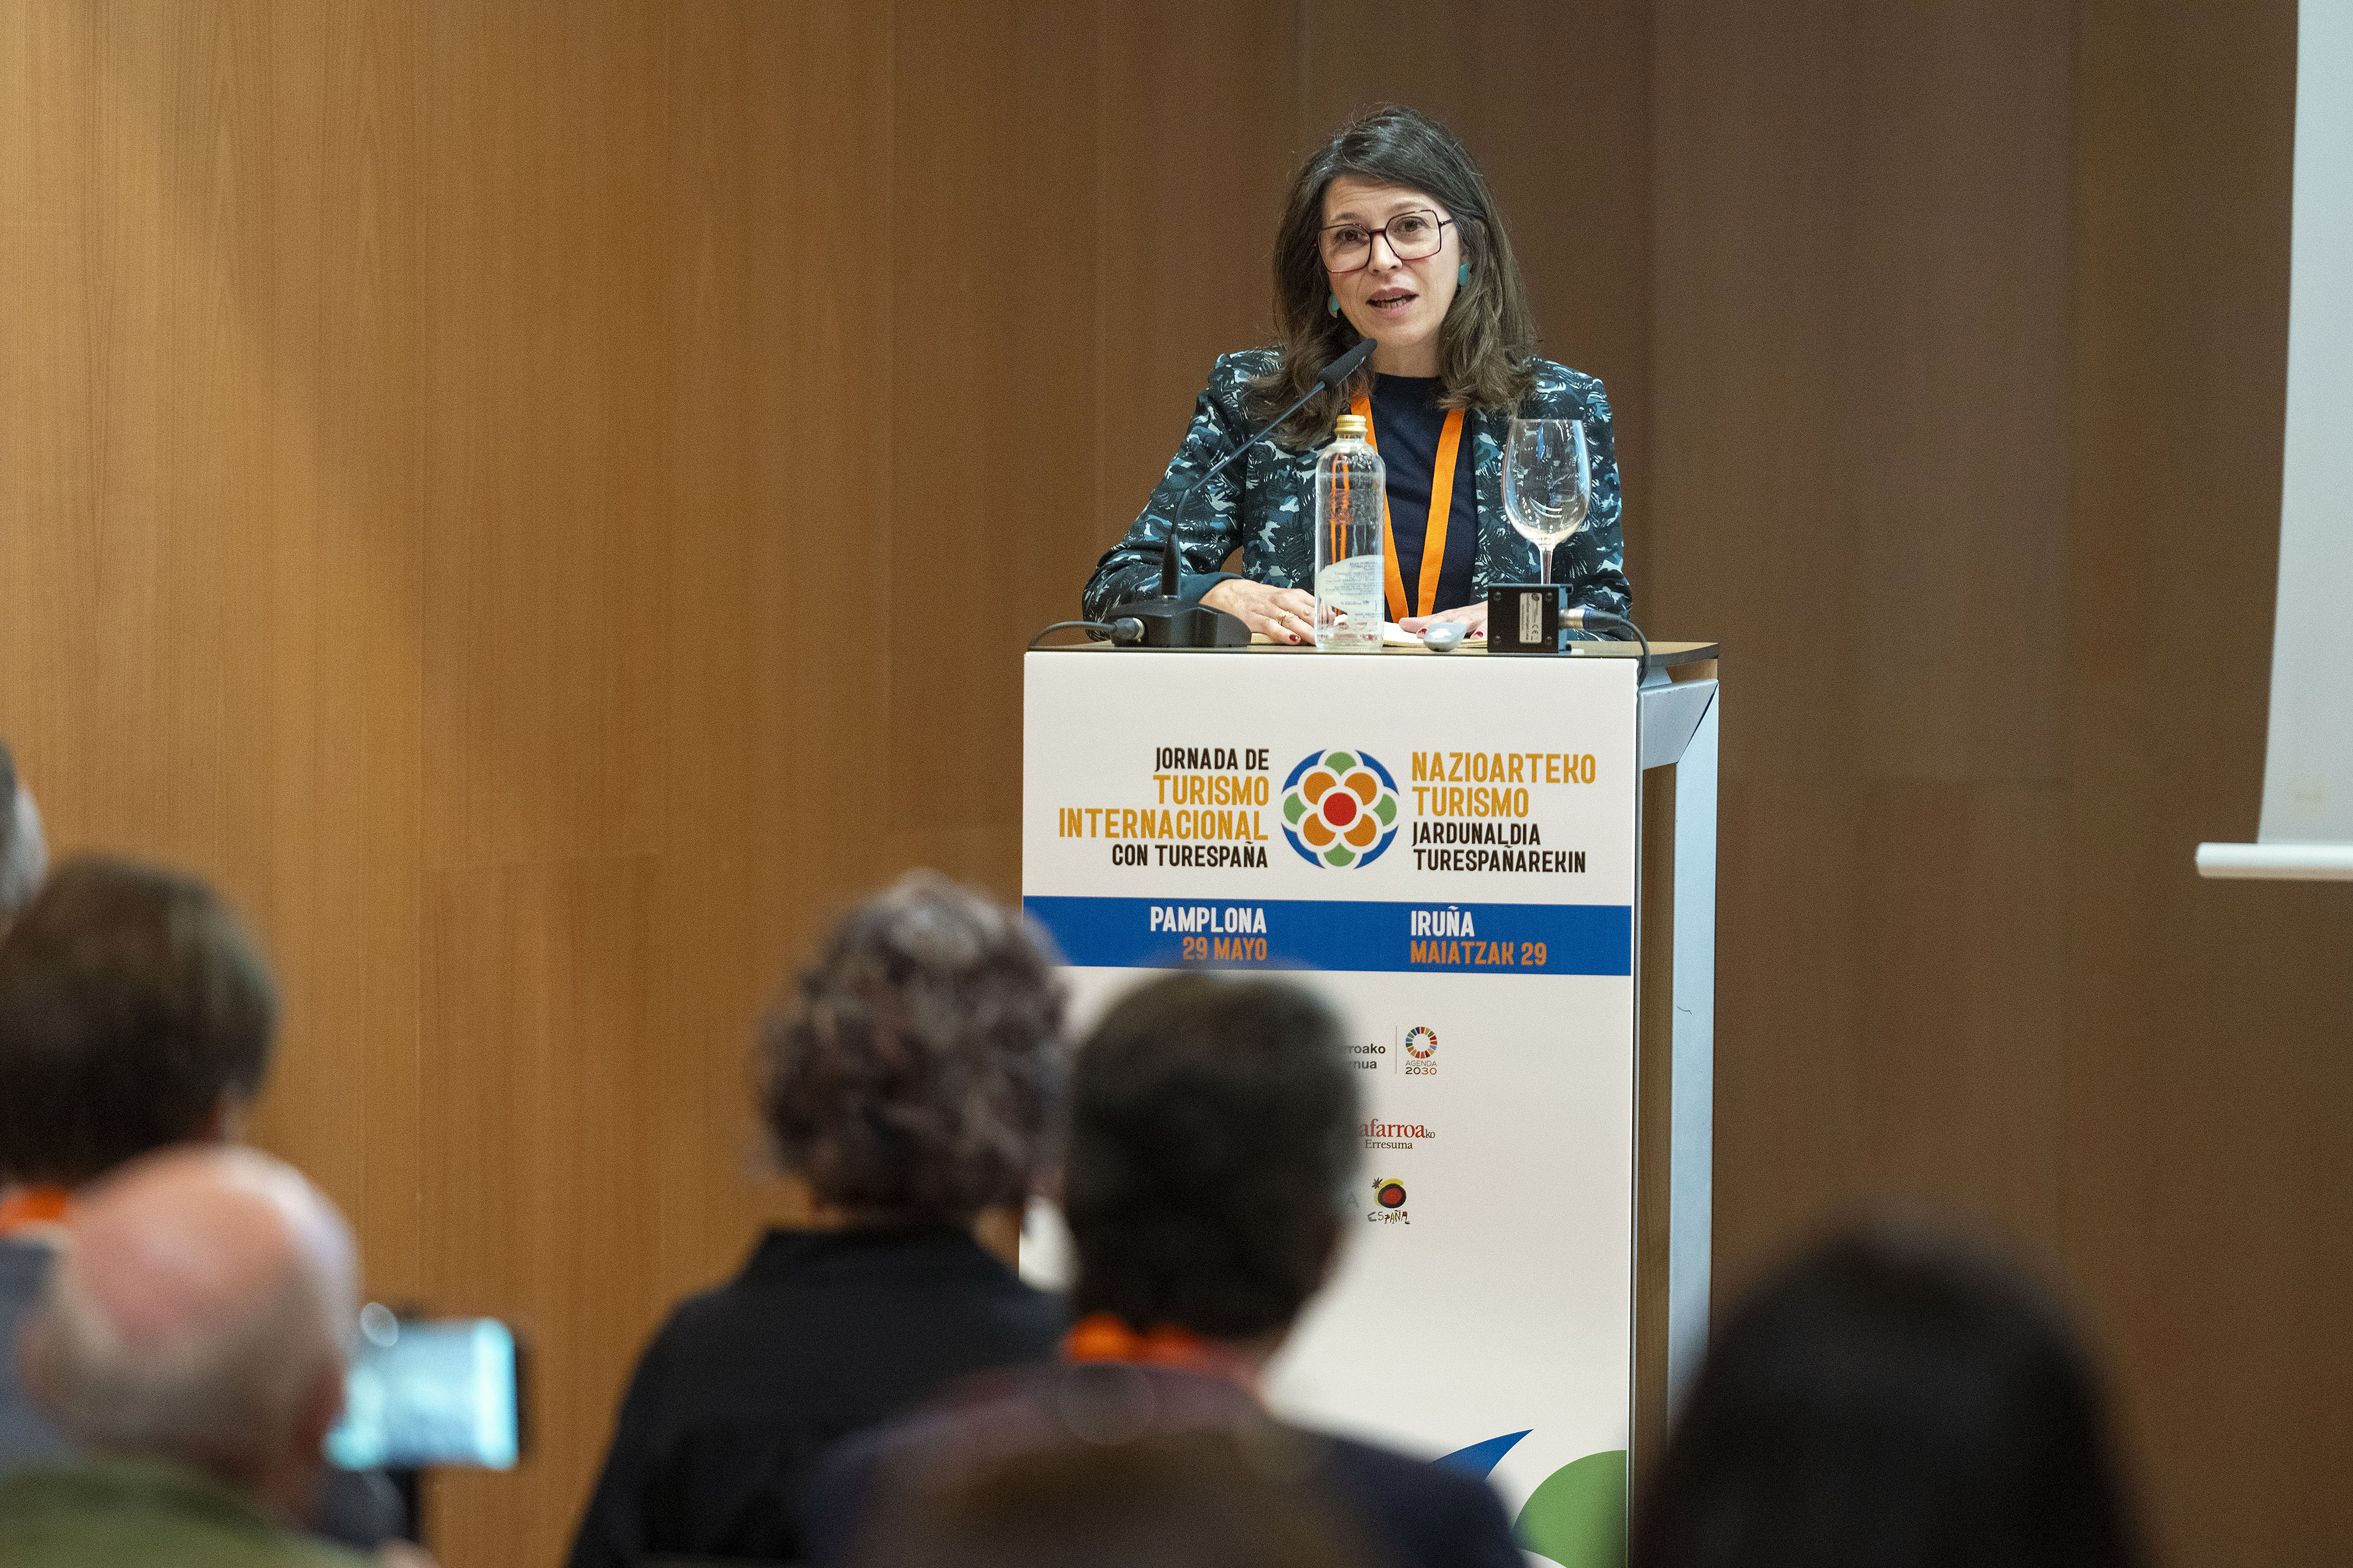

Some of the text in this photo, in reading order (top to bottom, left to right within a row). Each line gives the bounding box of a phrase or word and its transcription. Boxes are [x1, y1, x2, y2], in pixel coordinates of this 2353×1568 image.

[1154, 747, 1269, 773] JORNADA DE
[1411, 751, 1597, 785] NAZIOARTEKO
[1152, 774, 1269, 806] TURISMO
[1411, 786, 1530, 818] TURISMO
[1059, 808, 1269, 841] INTERNACIONAL
[1412, 821, 1541, 846] JARDUNALDIA
[1112, 840, 1269, 868] CON TURESPAÑA
[1412, 844, 1586, 874] TURESPAÑAREKIN
[1149, 906, 1268, 934] PAMPLONA
[1410, 906, 1475, 938] IRUÑA
[1181, 935, 1268, 961] 29 MAYO
[1410, 940, 1548, 967] MAIATZAK 29
[1347, 1043, 1386, 1054] roako
[1405, 1067, 1437, 1076] 2030
[1359, 1118, 1435, 1138] afarroako
[1365, 1139, 1413, 1149] Erresuma
[1367, 1209, 1410, 1225] ESPAÑA
